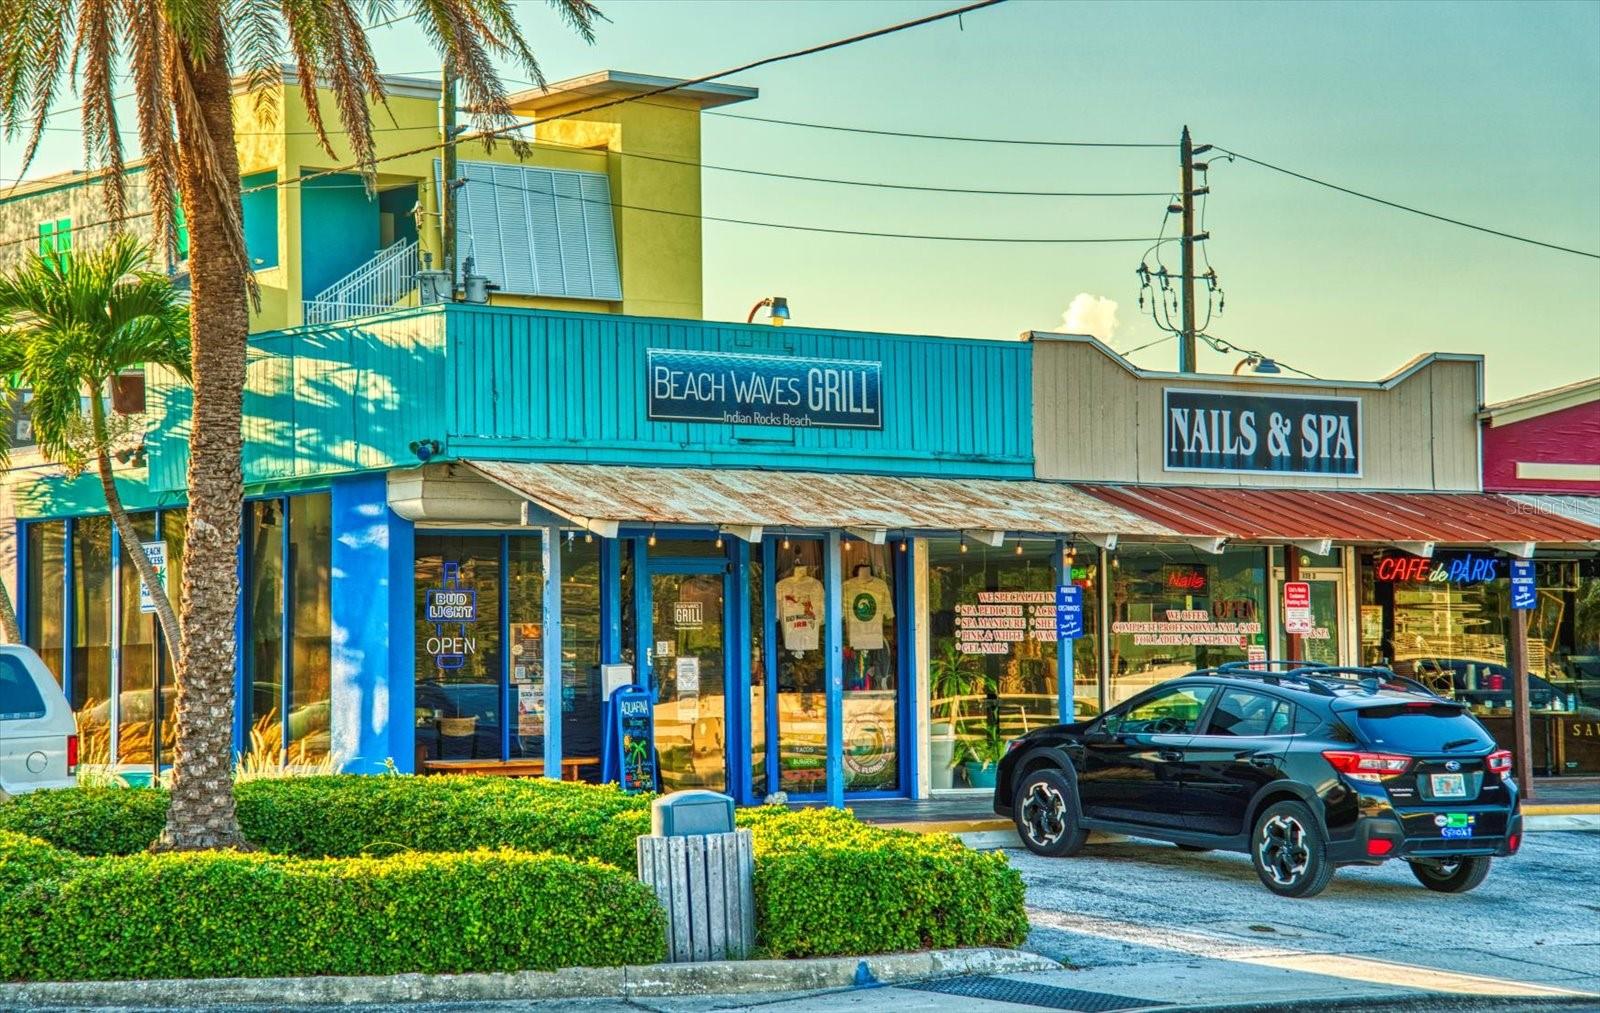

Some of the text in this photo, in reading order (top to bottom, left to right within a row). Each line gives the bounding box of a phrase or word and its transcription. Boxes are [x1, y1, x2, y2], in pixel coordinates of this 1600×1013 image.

[655, 366, 875, 414] BEACH WAVES GRILL
[723, 411, 812, 427] Indian Rocks Beach
[1170, 408, 1355, 459] NAILS & SPA
[1378, 557, 1431, 582] CAFE
[1429, 563, 1449, 582] de
[1168, 571, 1206, 588] Nails
[436, 593, 467, 605] BUD
[430, 606, 473, 618] LIGHT
[676, 608, 701, 622] GRILL
[961, 605, 1023, 616] SPA PEDICURE
[1166, 610, 1208, 621] WE OFFER
[961, 618, 1026, 629] SPA MANICURE
[1112, 622, 1261, 633] COMPLETE PROFESSIONAL NAIL CARE
[961, 630, 984, 641] PINK
[1134, 634, 1240, 645] FOR LADIES & GENTLEMEN
[426, 637, 476, 654] OPEN
[961, 642, 1009, 654] GEL NAILS
